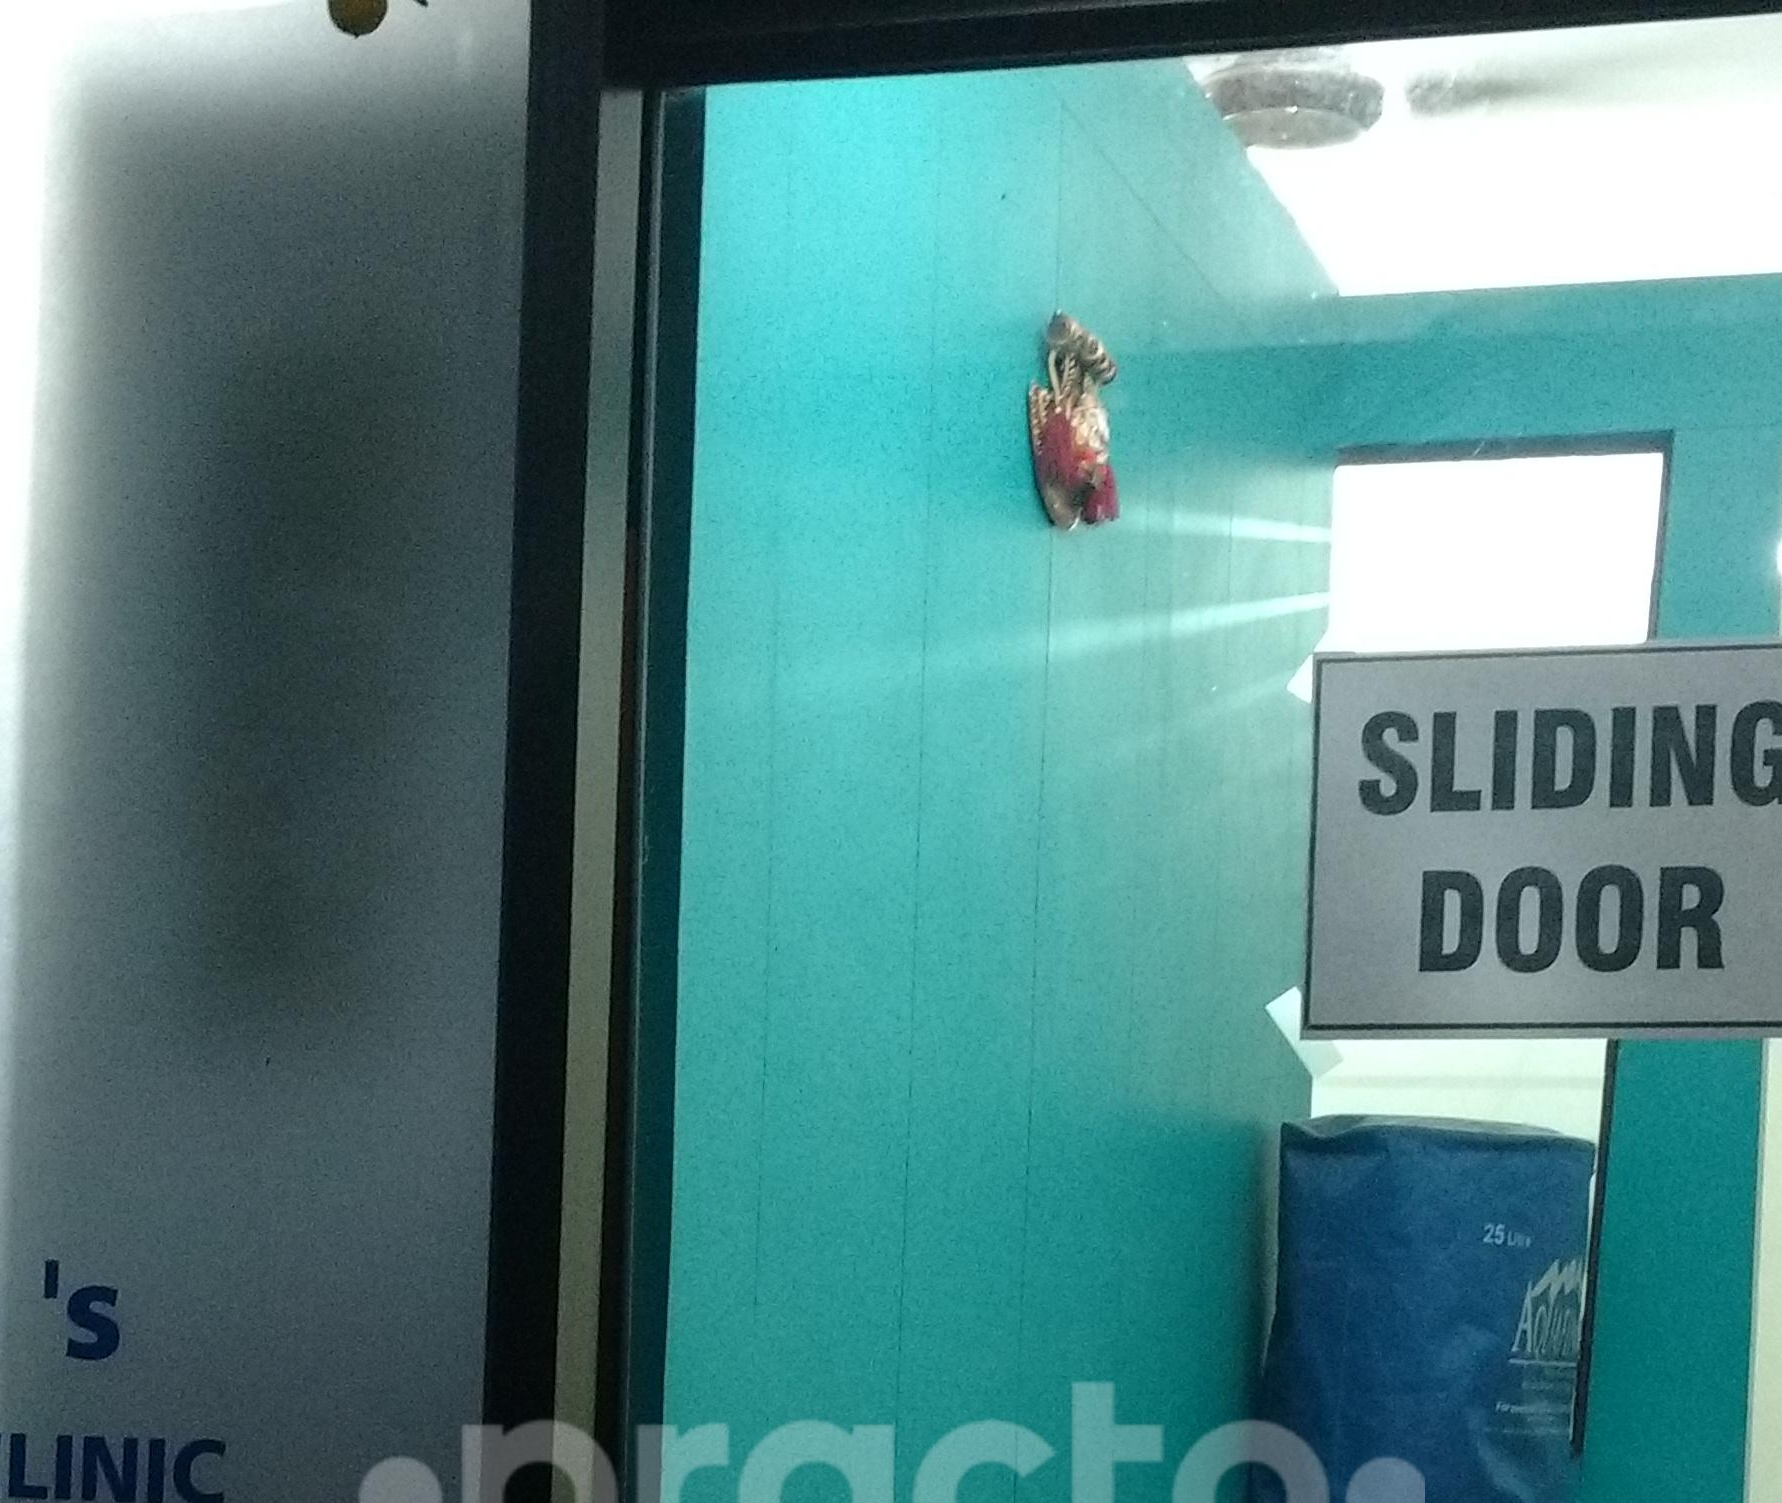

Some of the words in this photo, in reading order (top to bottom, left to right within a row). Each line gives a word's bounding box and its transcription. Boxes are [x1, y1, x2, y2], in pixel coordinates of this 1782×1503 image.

[1419, 865, 1725, 973] DOOR
[1483, 1221, 1506, 1246] 25
[43, 1260, 122, 1362] 's
